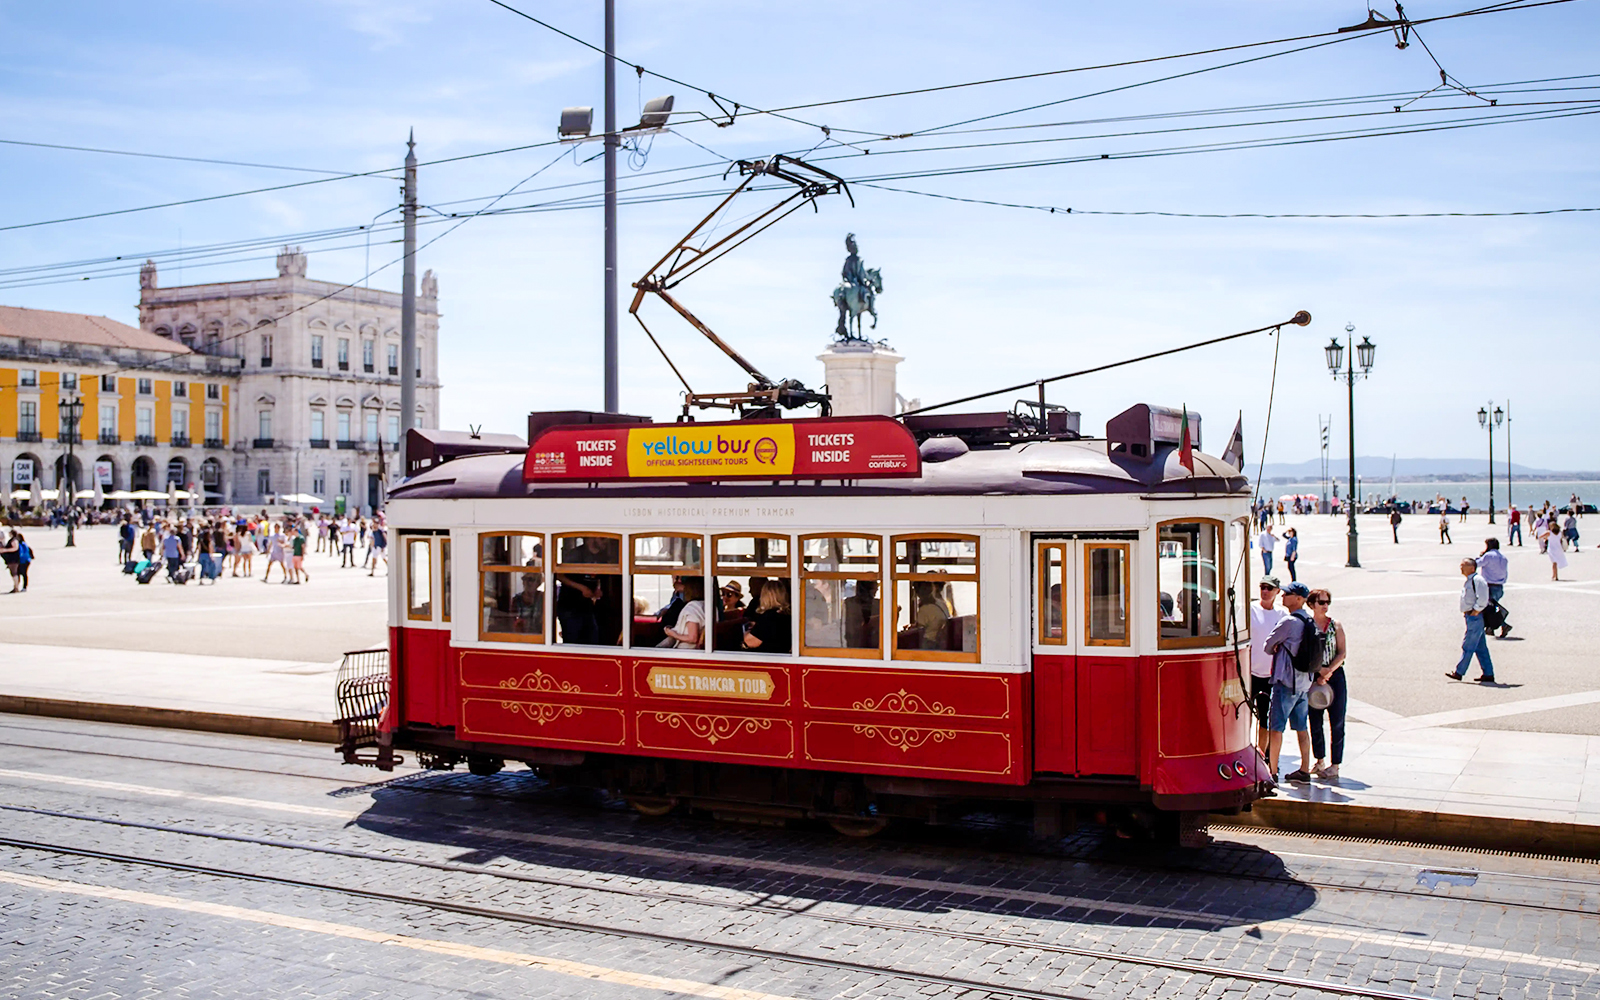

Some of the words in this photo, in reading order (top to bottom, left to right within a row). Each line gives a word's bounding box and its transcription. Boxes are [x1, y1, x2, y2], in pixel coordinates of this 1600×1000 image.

[576, 439, 617, 452] TICKETS
[642, 435, 712, 456] yellow
[717, 434, 751, 454] bus
[808, 433, 855, 446] TICKETS
[579, 455, 613, 467] INSIDE
[646, 459, 676, 467] OFFICIAL
[677, 458, 723, 466] SIGHTSEEING
[724, 457, 748, 465] TOURS
[811, 450, 850, 463] INSIDE
[16, 462, 31, 470] CAN
[868, 460, 901, 469] carristur
[16, 473, 30, 481] CAN
[623, 508, 652, 517] LISBON
[657, 508, 705, 517] HISTORICAL
[712, 507, 750, 517] PREMIUM
[756, 507, 795, 517] TRAMCAR
[655, 673, 687, 690] HILLS
[688, 675, 736, 693] TRAMCAR
[737, 677, 767, 694] TOUR
